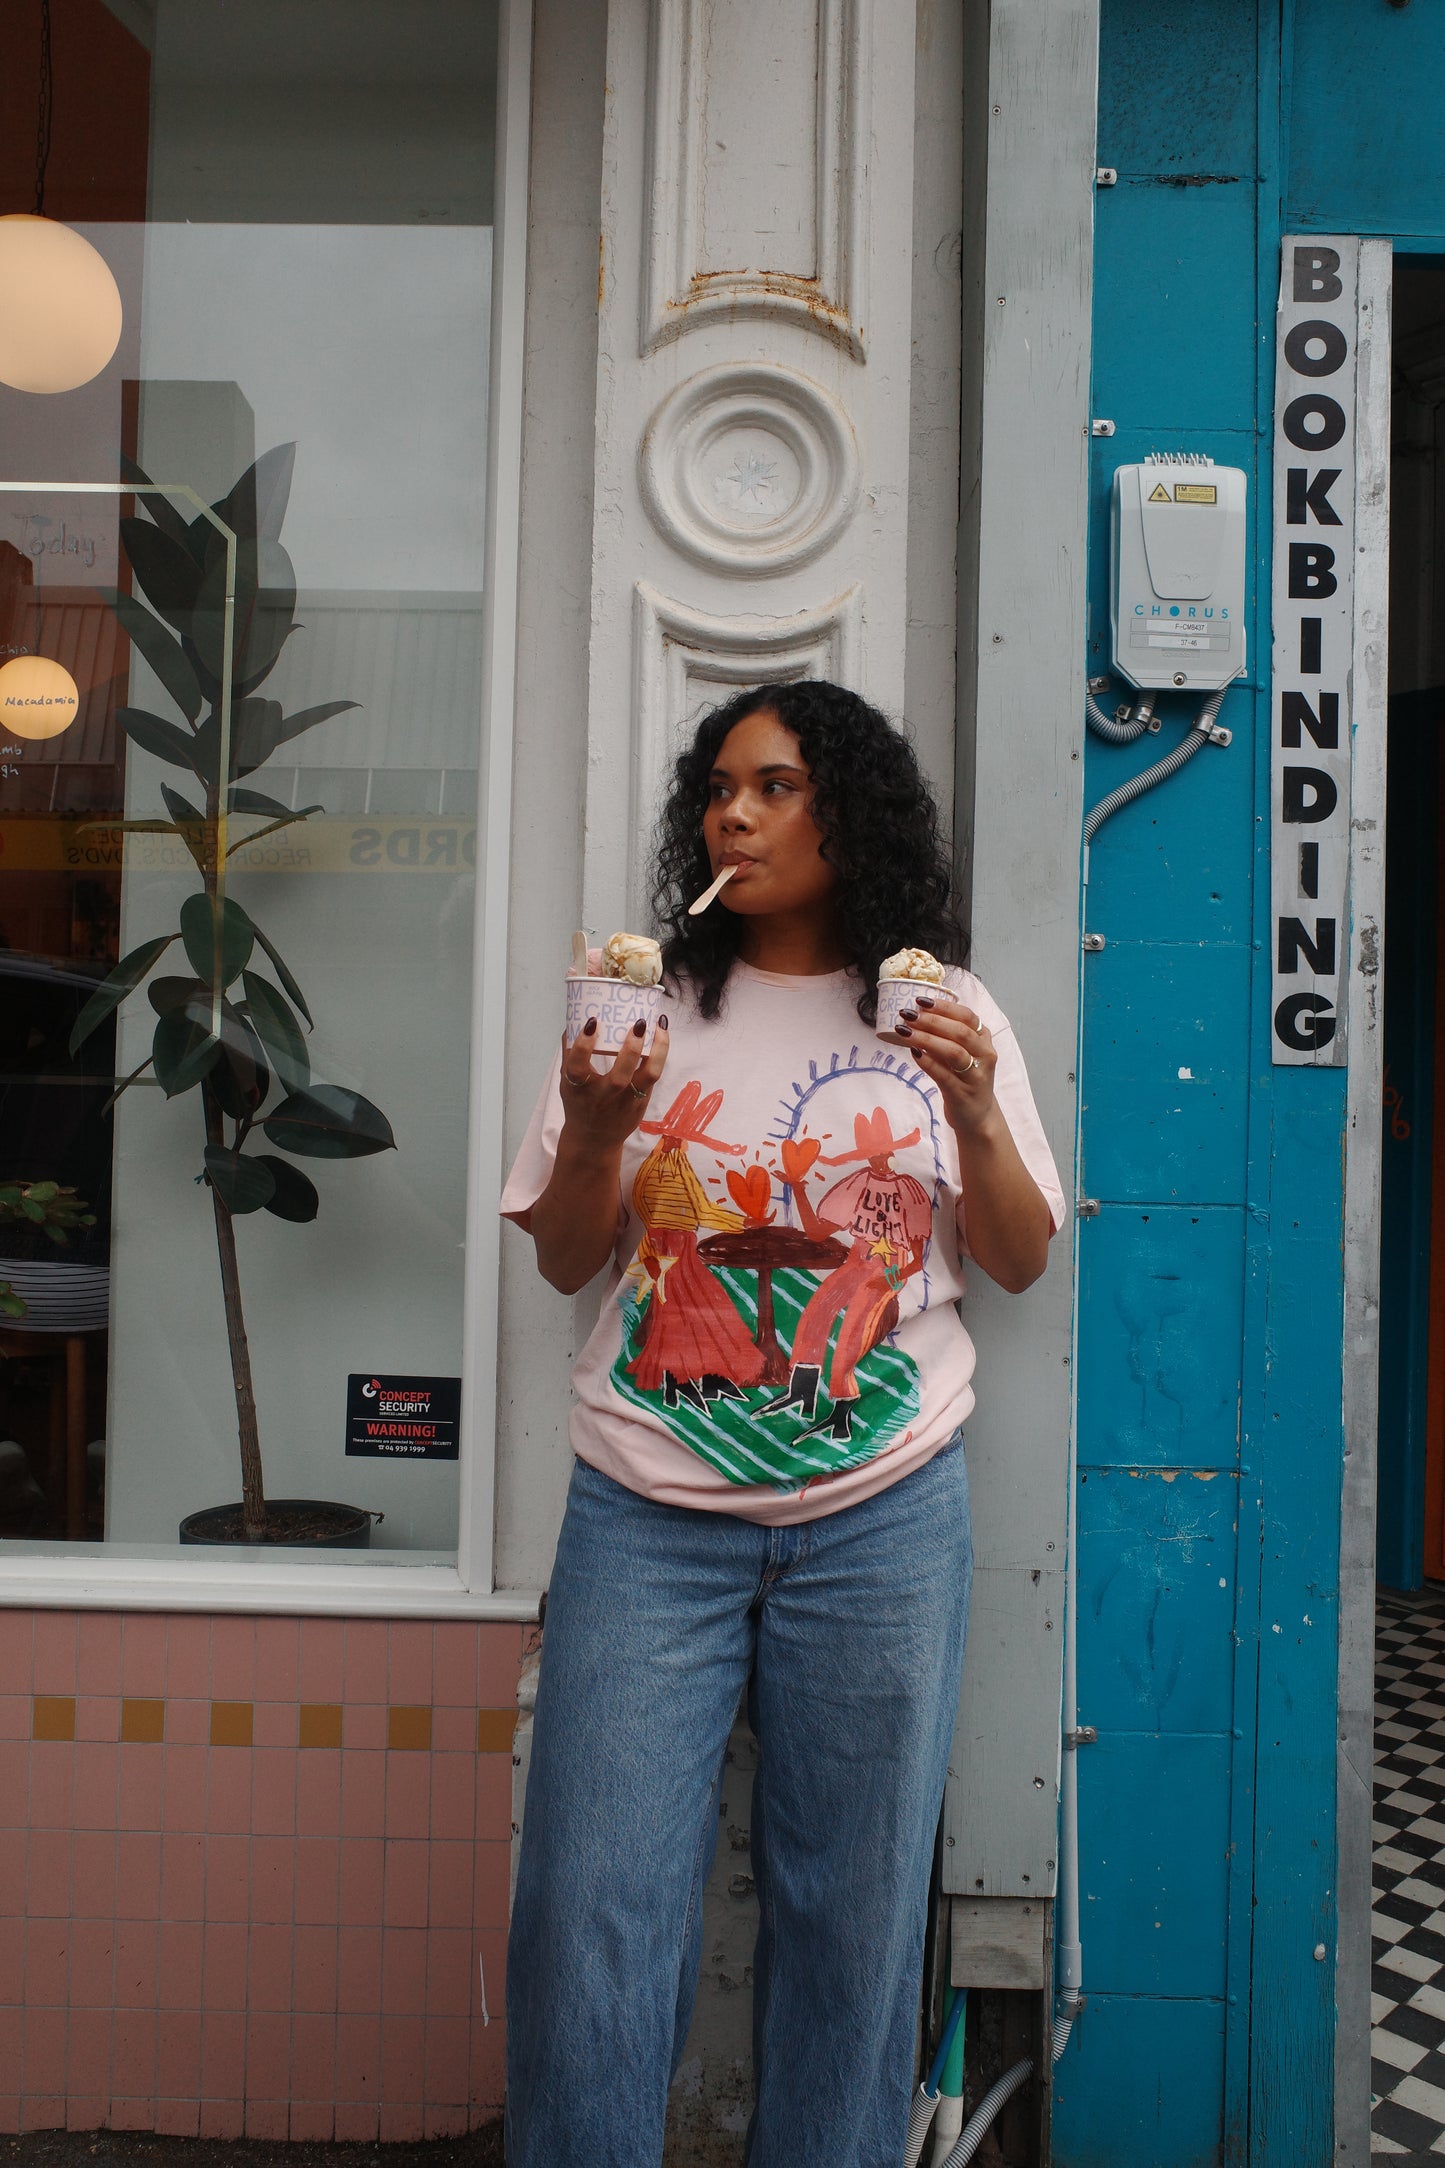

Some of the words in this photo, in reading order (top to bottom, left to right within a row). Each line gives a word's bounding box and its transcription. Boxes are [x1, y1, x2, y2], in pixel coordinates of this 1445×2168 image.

[11, 512, 96, 568] Today
[1134, 604, 1229, 619] CHORUS
[1274, 246, 1349, 1053] BOOKBINDING
[5, 696, 75, 706] Macadamia
[607, 982, 645, 1005] ICE
[862, 1189, 900, 1213] LOVE
[854, 1215, 904, 1241] LIGHT
[379, 1390, 431, 1403] CONCEPT
[379, 1402, 431, 1413] SECURITY
[366, 1423, 436, 1438] WARNING!
